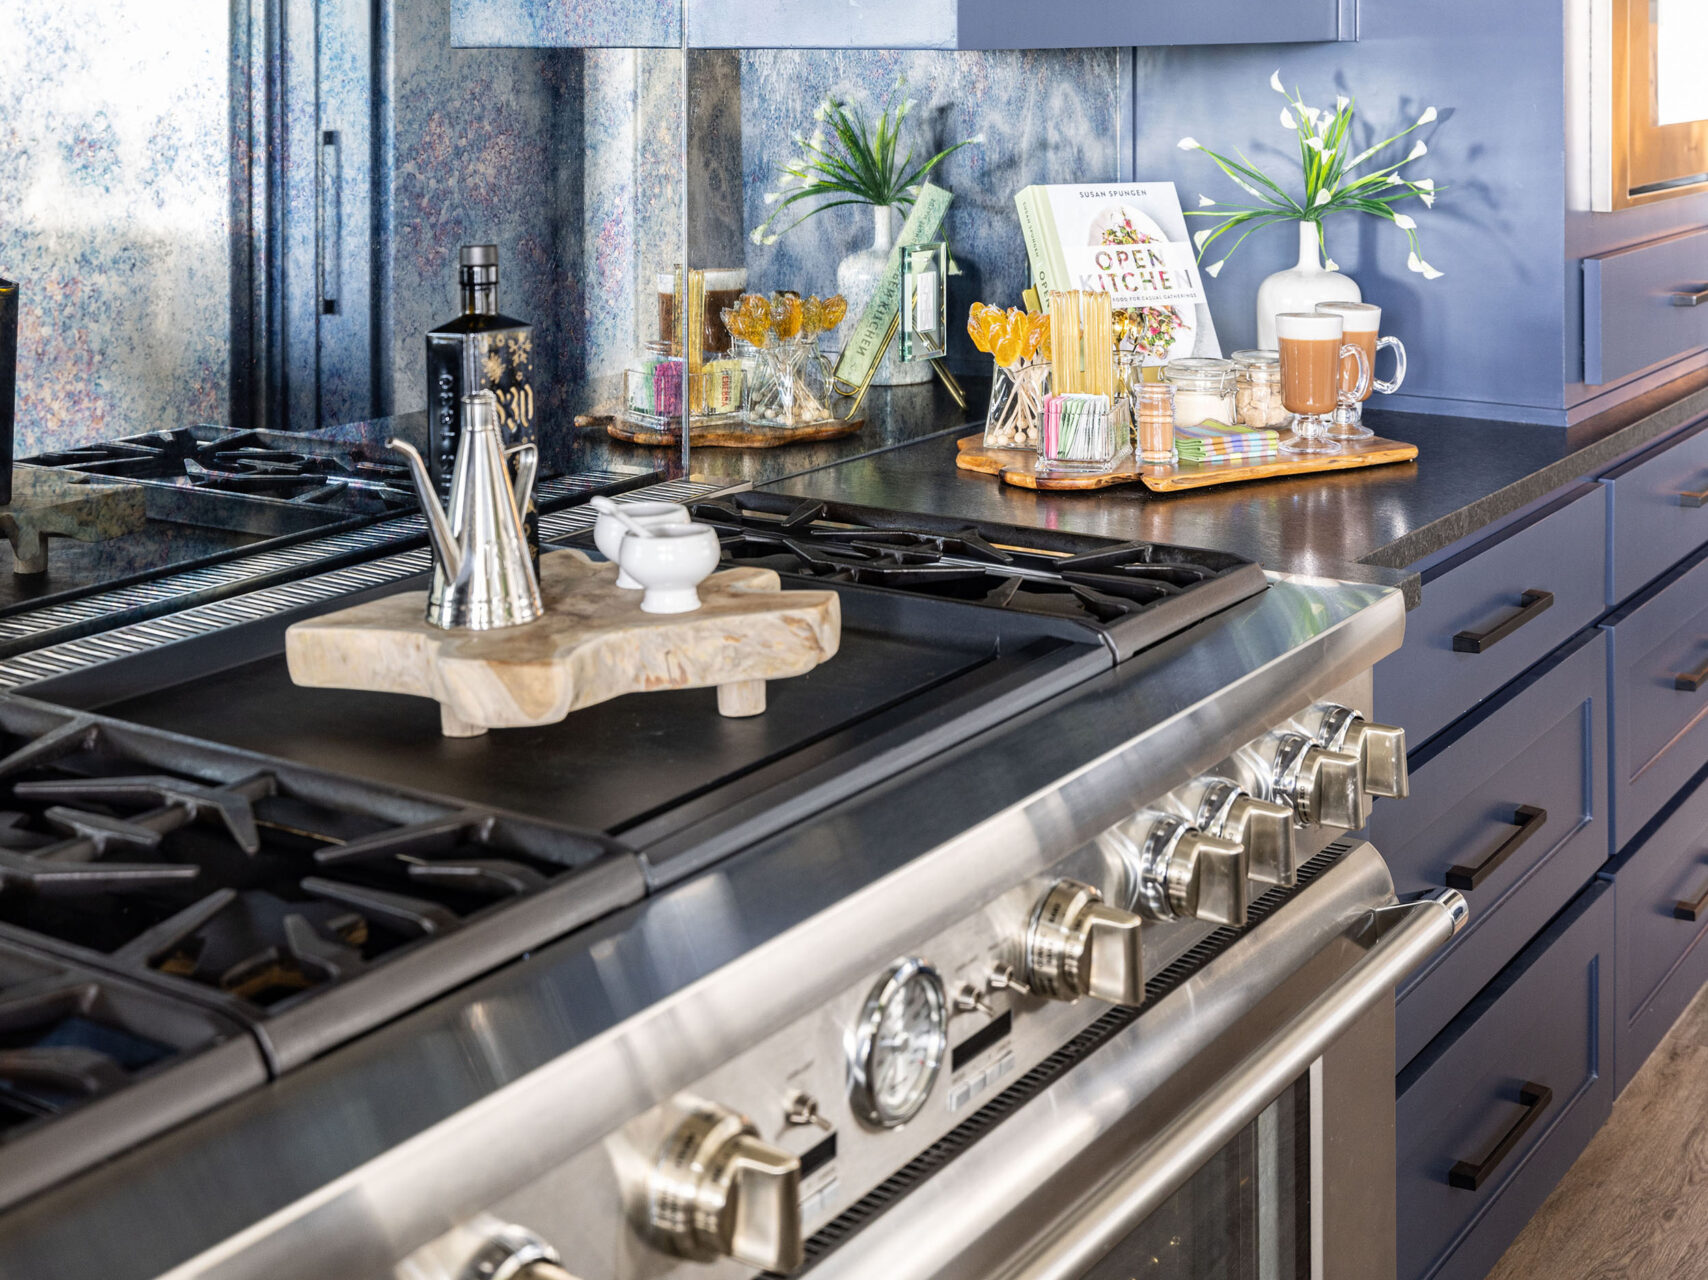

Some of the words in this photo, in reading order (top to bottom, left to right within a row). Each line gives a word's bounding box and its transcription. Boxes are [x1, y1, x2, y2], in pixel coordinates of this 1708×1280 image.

[1079, 190, 1106, 199] SUSAN
[1108, 189, 1147, 199] SPUNGEN
[1095, 248, 1166, 271] OPEN
[1079, 269, 1194, 293] KITCHEN
